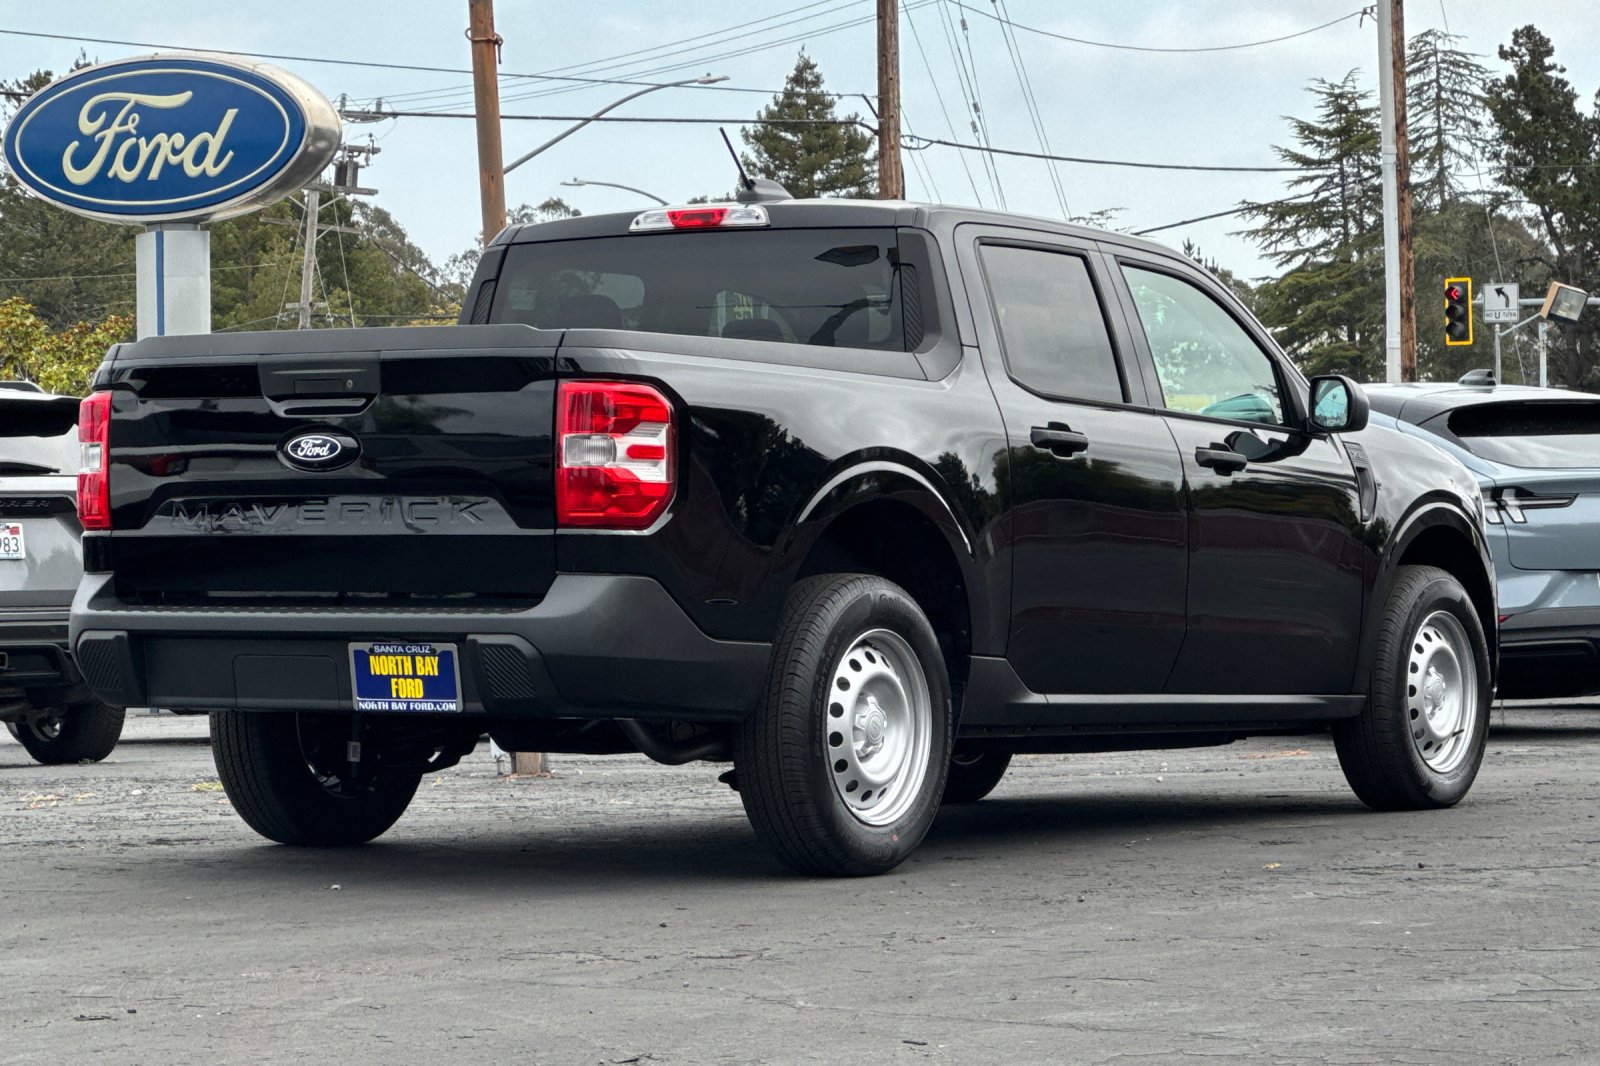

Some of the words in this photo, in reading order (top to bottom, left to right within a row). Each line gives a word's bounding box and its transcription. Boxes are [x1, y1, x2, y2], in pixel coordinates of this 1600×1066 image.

[62, 90, 239, 186] Ford
[1494, 311, 1501, 319] U
[297, 439, 331, 457] Ford
[171, 499, 488, 526] MAVERICK
[0, 536, 20, 553] 83
[373, 645, 404, 653] SANTA
[369, 655, 413, 675] NORTH
[415, 656, 439, 676] BAY
[390, 678, 424, 698] FORD
[359, 701, 389, 710] NORTH
[391, 702, 408, 710] BAY
[409, 702, 457, 711] FORD.COM
